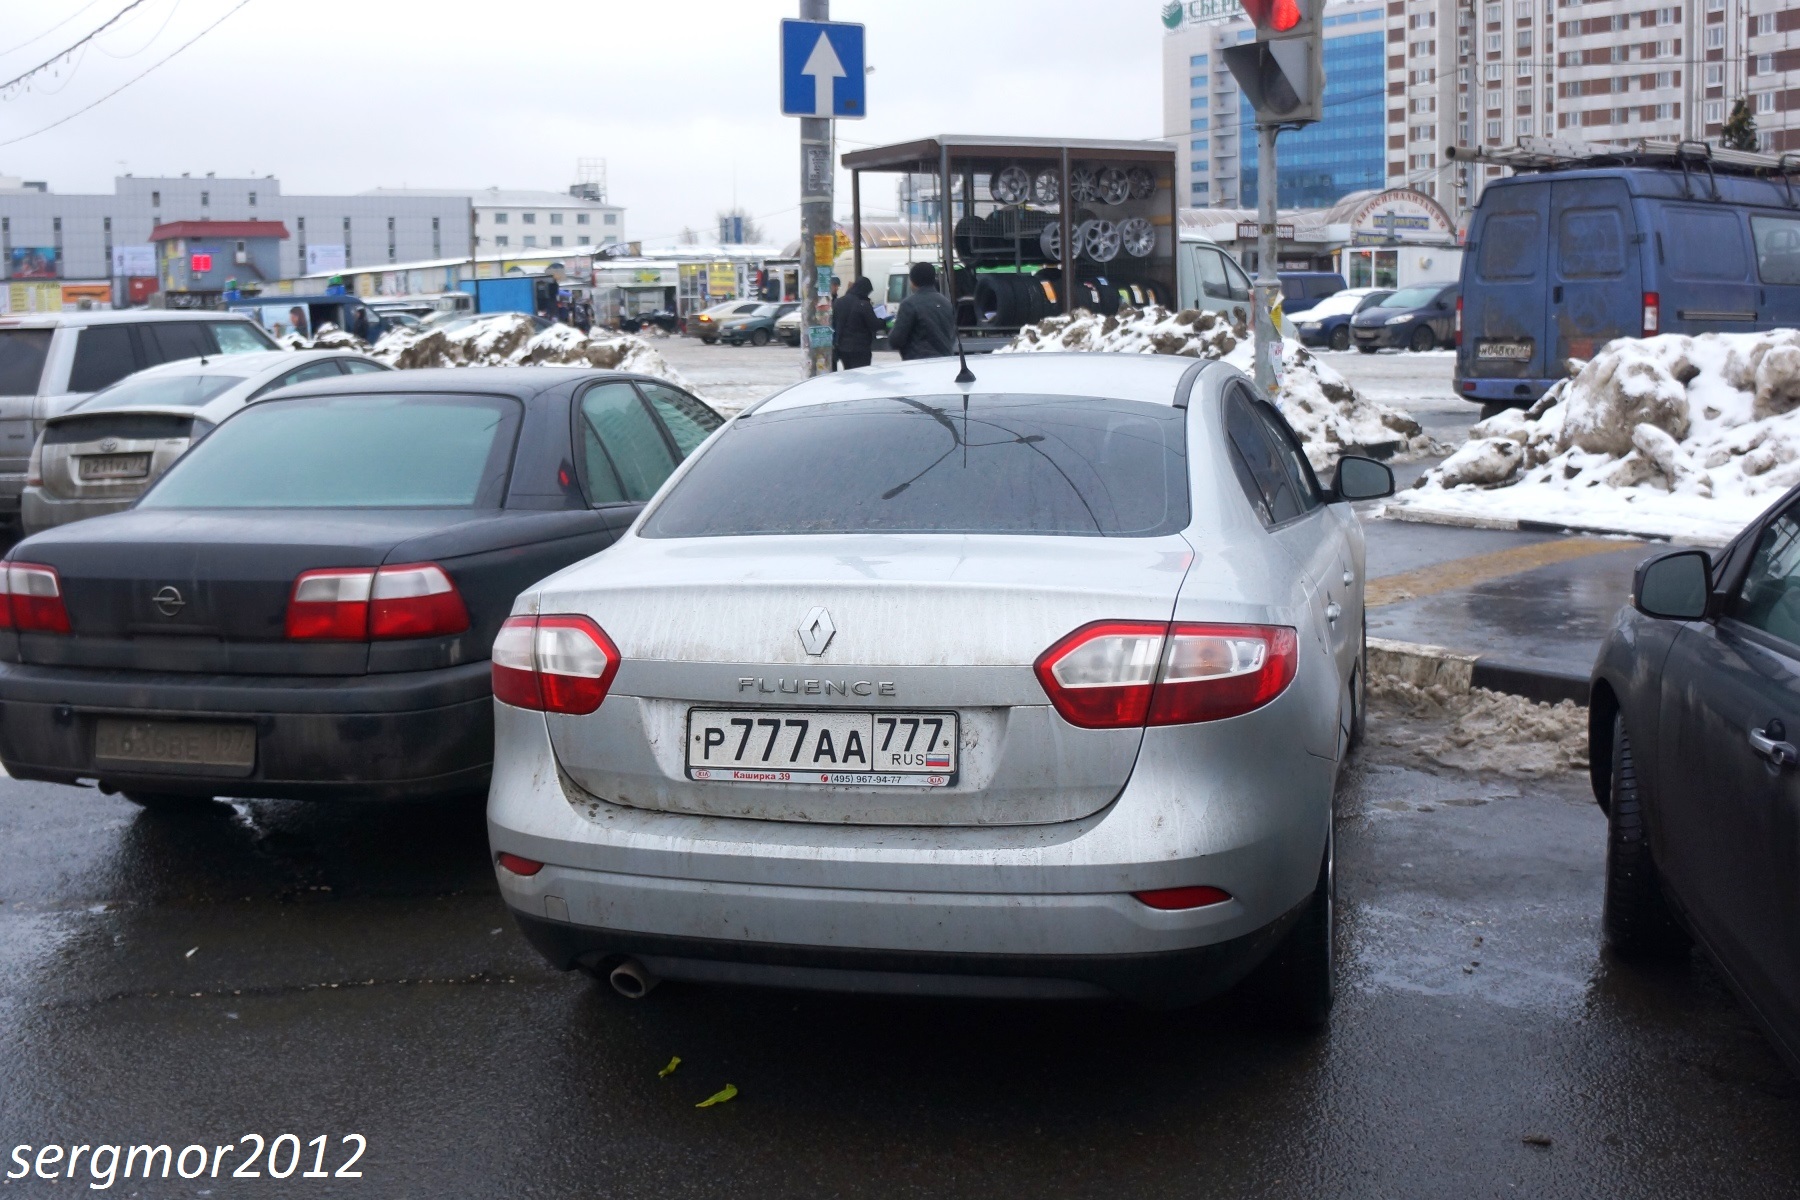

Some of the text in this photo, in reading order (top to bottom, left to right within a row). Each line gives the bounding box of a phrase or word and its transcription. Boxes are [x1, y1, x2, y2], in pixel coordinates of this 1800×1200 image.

[738, 677, 896, 697] FLUENCE
[703, 717, 943, 764] Р777АА 777
[891, 753, 925, 766] RUS
[696, 770, 710, 778] KIA
[733, 771, 791, 781] Каширка 39
[830, 774, 902, 784] (495) 967-94-77
[928, 776, 943, 785] KIA
